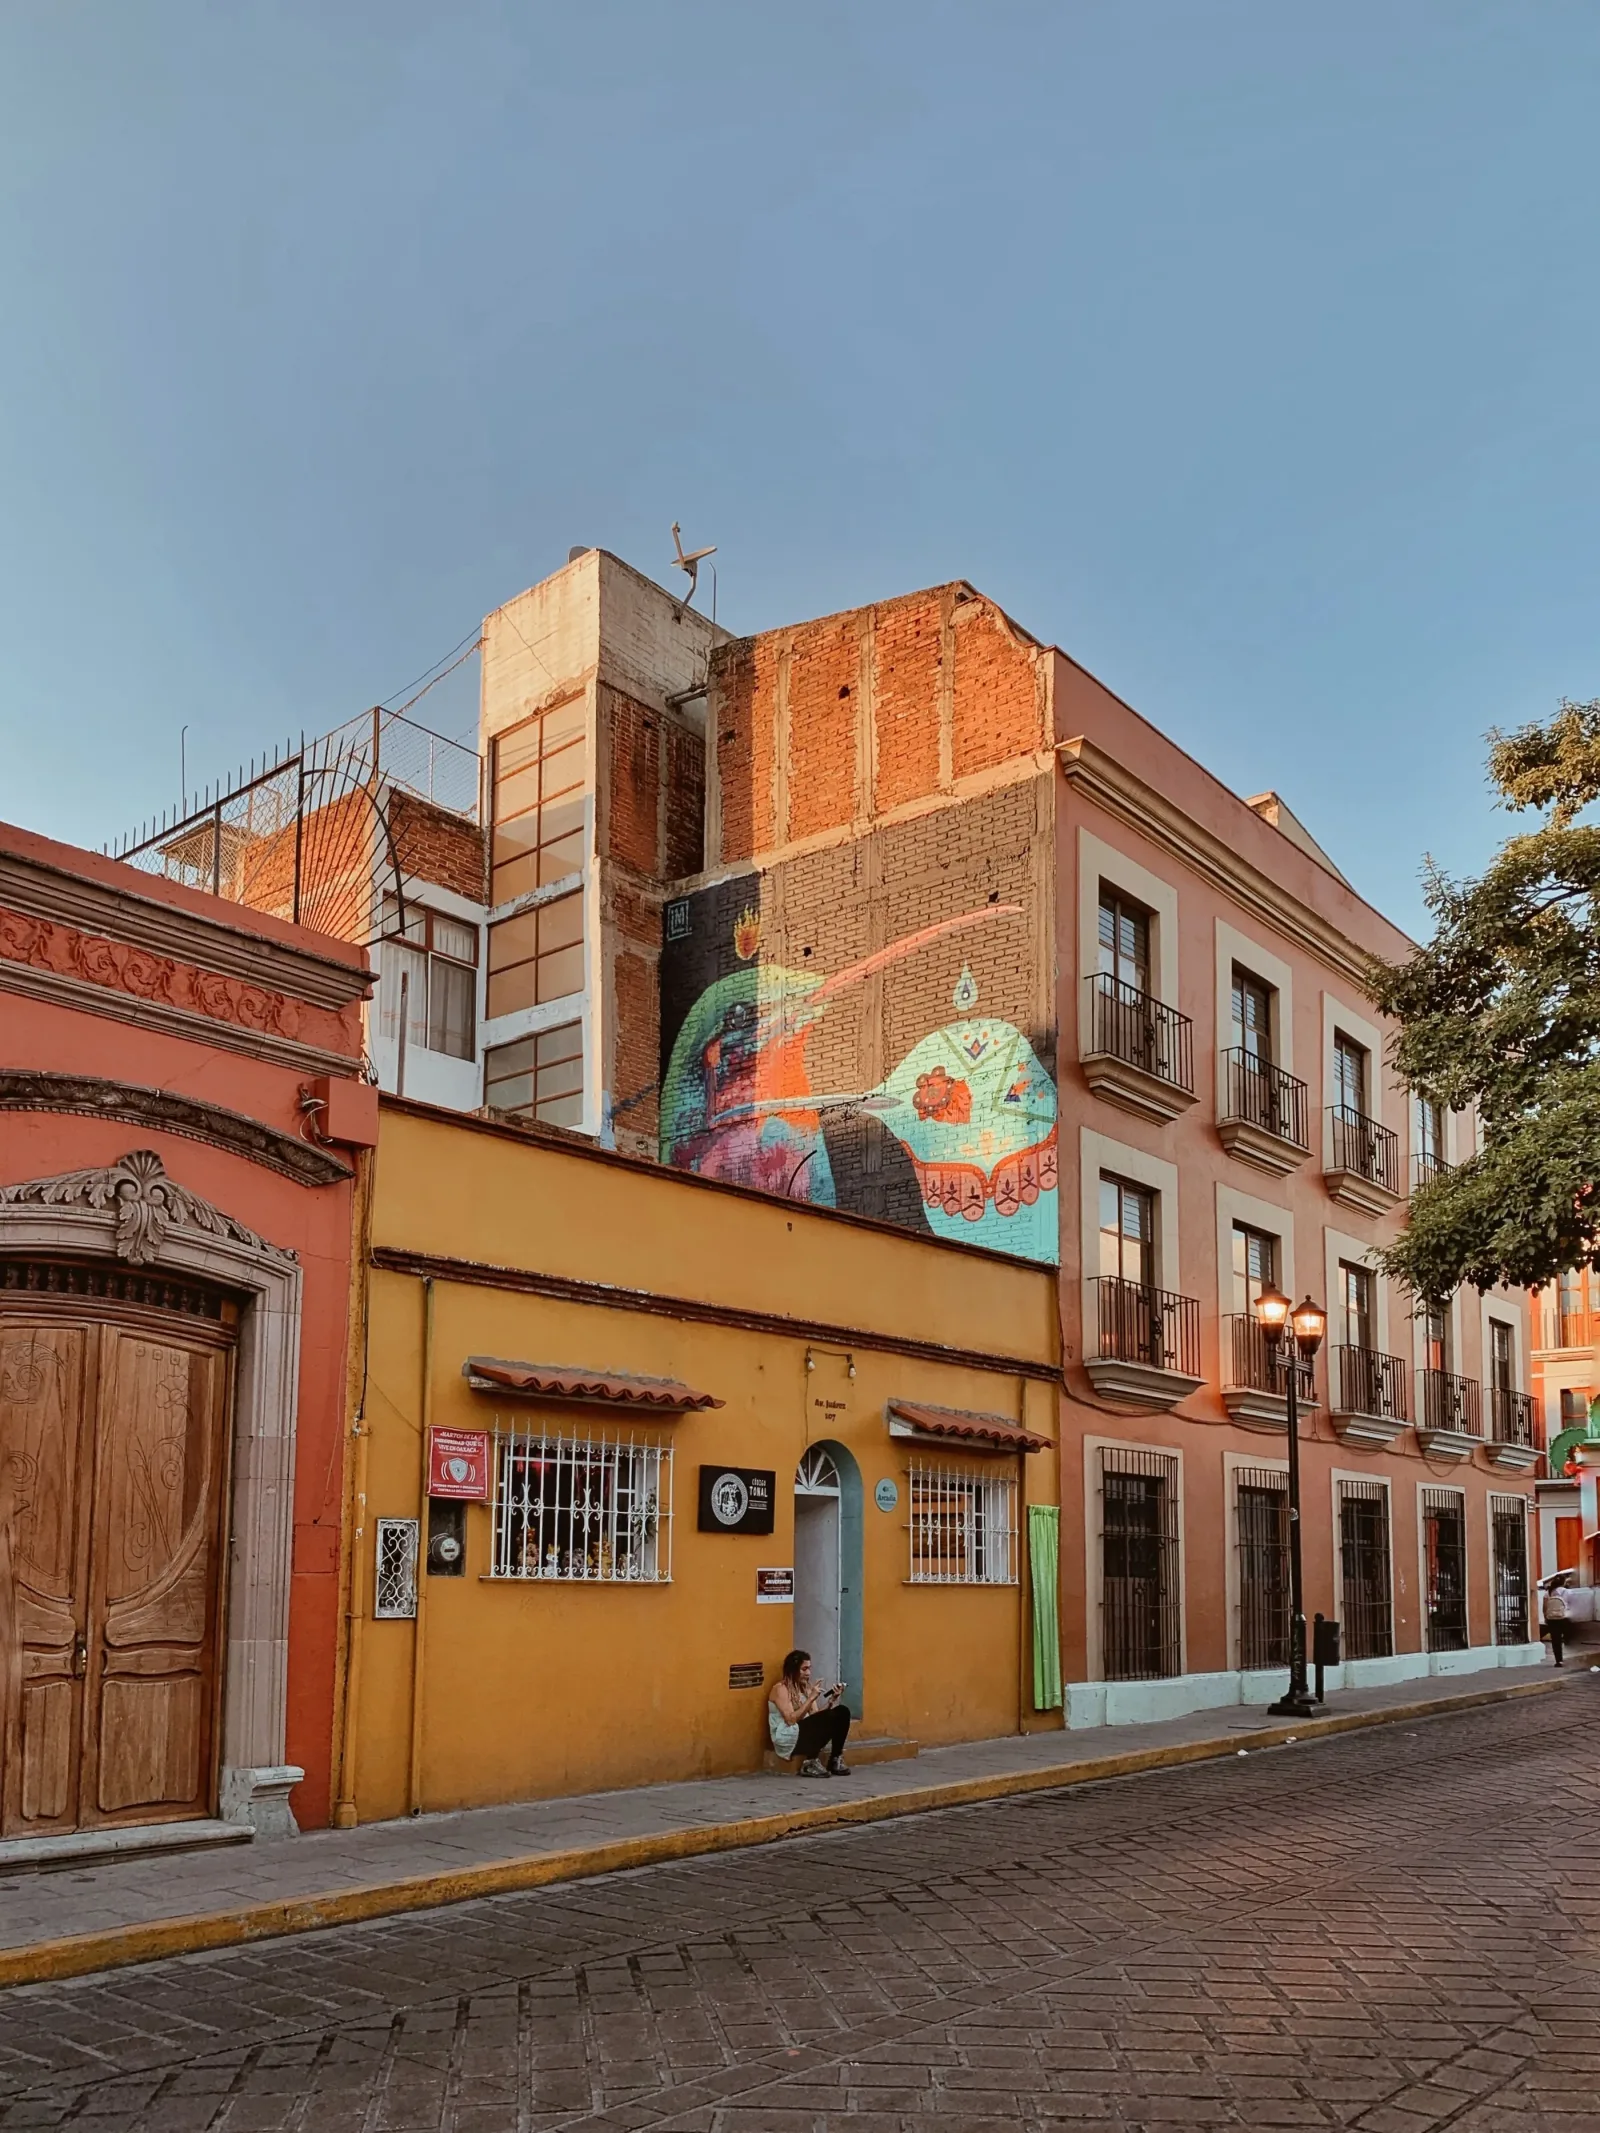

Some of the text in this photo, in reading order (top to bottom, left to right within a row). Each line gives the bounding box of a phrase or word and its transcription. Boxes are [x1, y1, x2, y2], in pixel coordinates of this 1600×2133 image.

[815, 1398, 846, 1410] Av. Juárez
[825, 1412, 837, 1422] 107
[749, 1486, 768, 1498] TONAL
